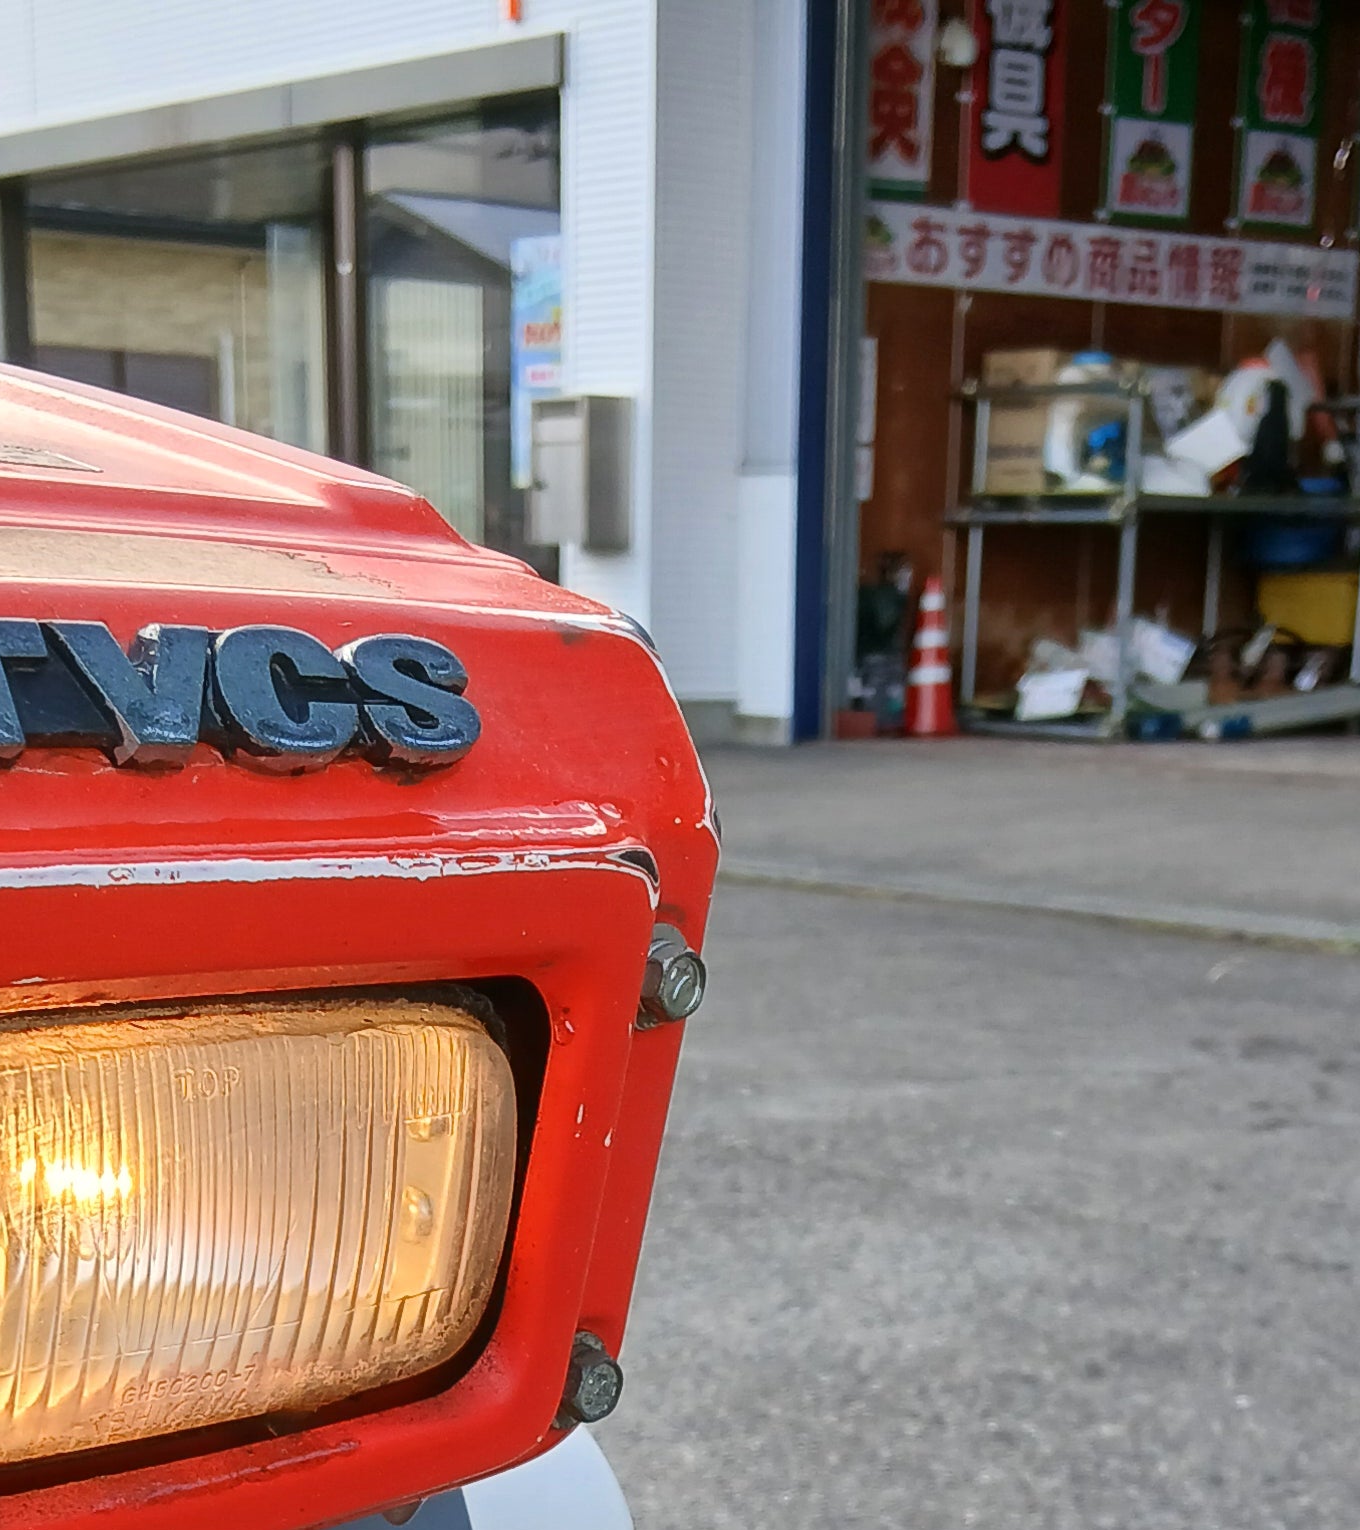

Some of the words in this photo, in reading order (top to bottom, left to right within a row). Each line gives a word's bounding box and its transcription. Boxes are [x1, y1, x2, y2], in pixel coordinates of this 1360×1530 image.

[905, 215, 1244, 305] おすすめ商品情報
